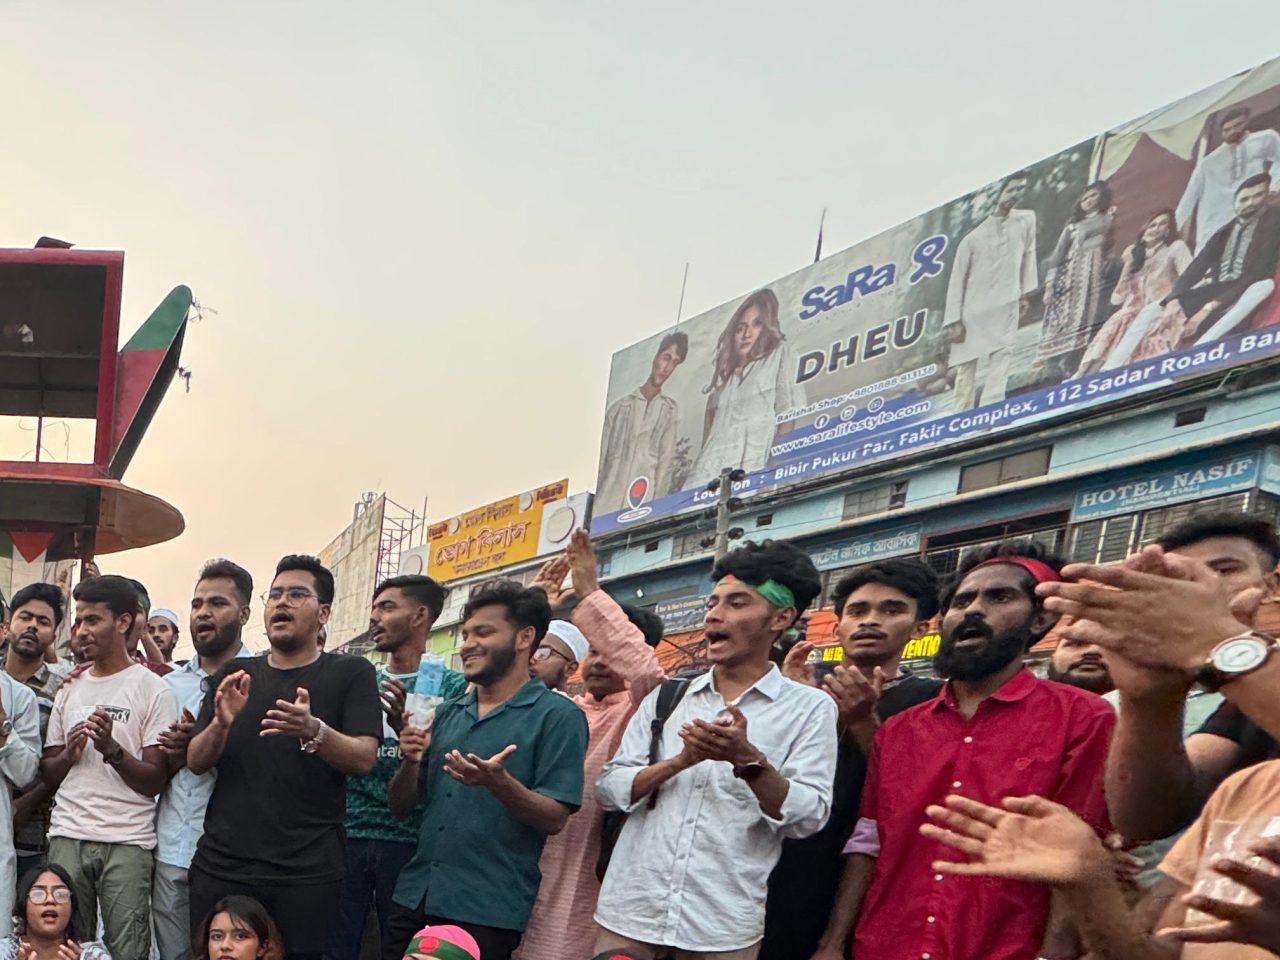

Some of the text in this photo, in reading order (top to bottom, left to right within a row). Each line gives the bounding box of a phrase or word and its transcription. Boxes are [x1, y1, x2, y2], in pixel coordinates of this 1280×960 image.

[799, 262, 896, 320] SaRa
[795, 308, 928, 384] DHEU
[771, 401, 930, 456] www.saralifestyle.com
[774, 460, 808, 480] Bibir
[812, 447, 859, 470] Pukur
[899, 424, 945, 446] Fakir
[948, 398, 1038, 433] Complex,
[1046, 385, 1081, 406] 112
[1087, 364, 1156, 392] Sadar
[1160, 342, 1230, 373] Road,
[1079, 479, 1164, 508] HOTEL
[1172, 459, 1254, 488] NASIF
